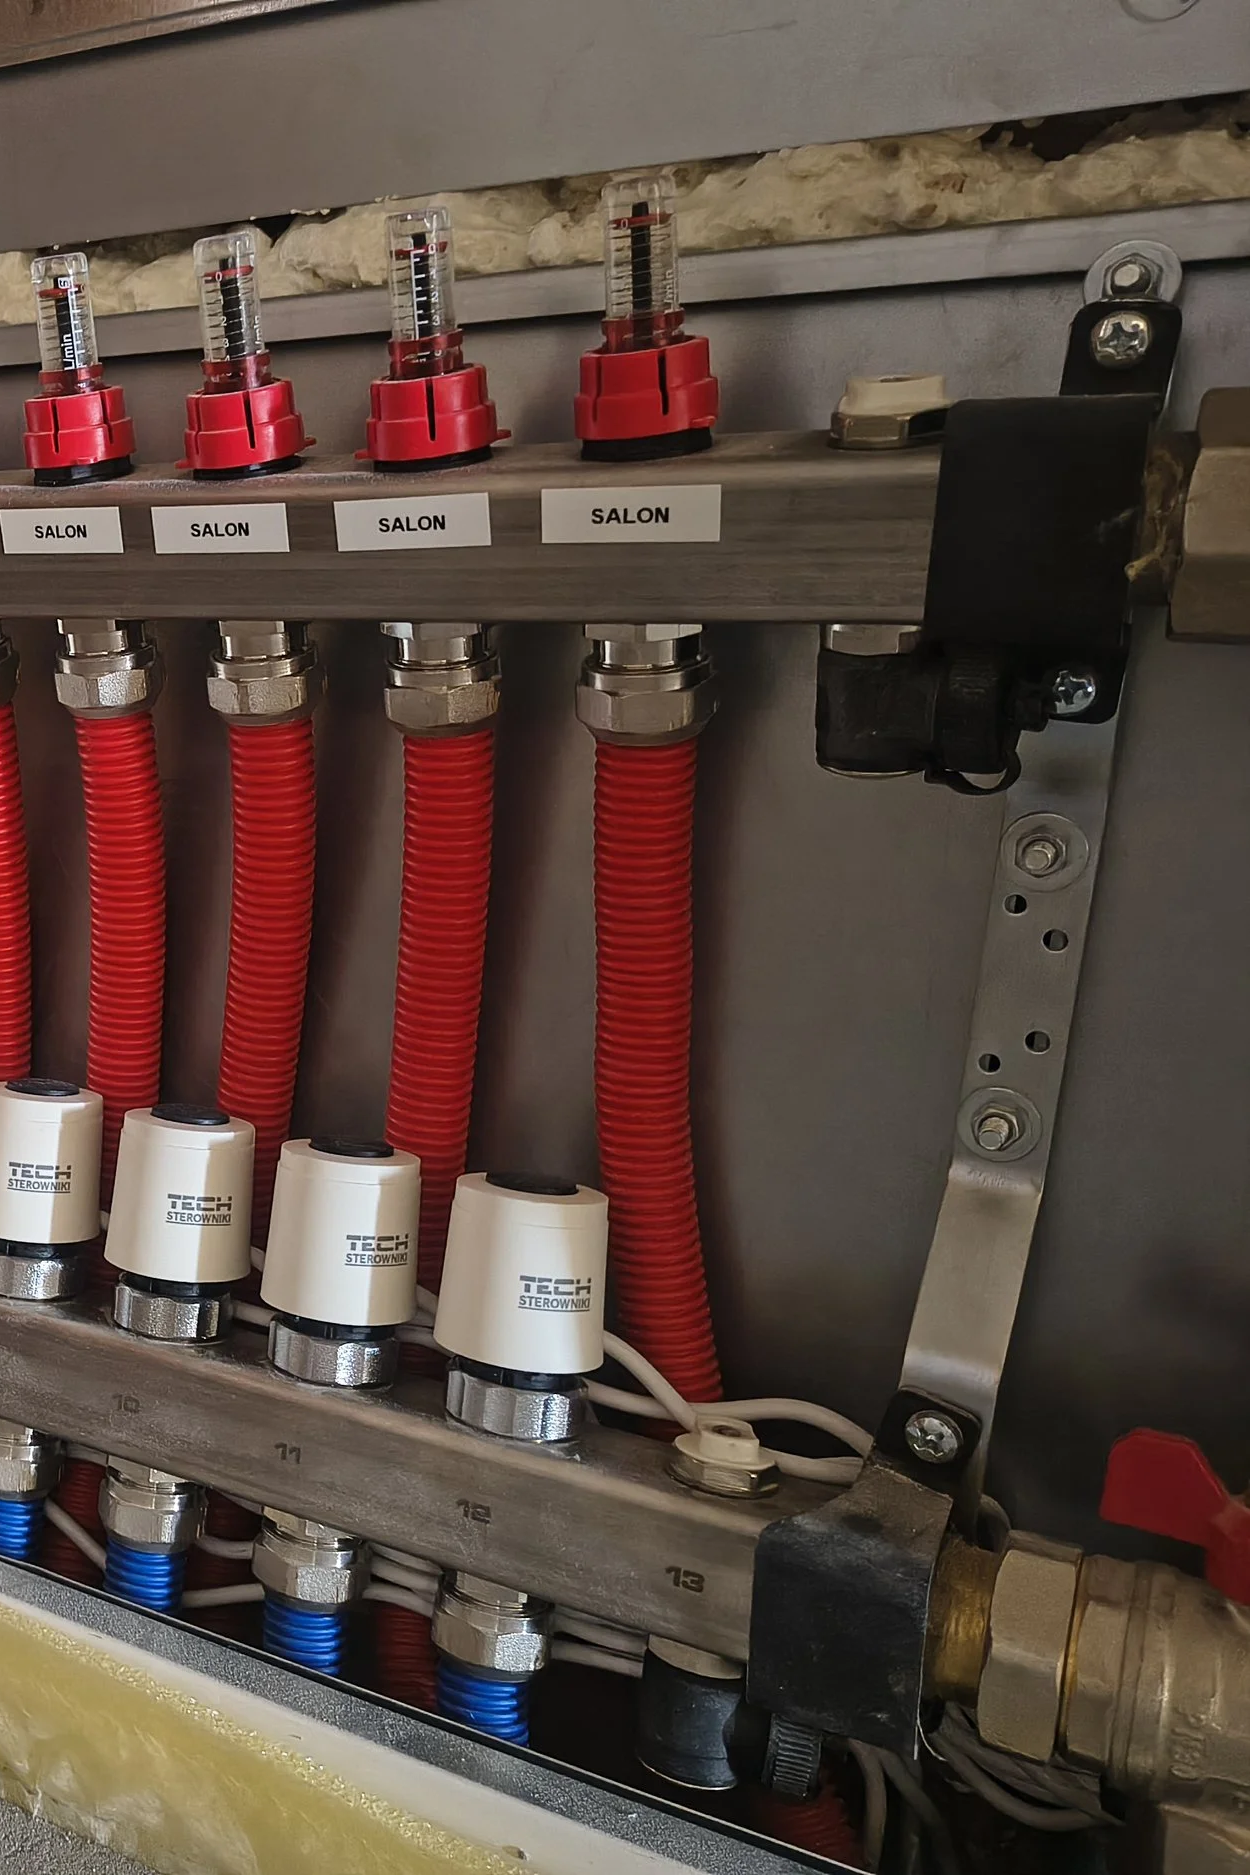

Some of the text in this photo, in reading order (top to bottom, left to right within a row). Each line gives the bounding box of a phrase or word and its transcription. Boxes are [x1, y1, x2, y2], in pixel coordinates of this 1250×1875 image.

[61, 334, 76, 371] L/min
[378, 514, 446, 533] SALON
[590, 506, 670, 525] SALON
[34, 525, 88, 538] SALON
[190, 522, 249, 538] SALON
[8, 1161, 72, 1180] TECH
[7, 1178, 71, 1191] STEROWNIKI
[167, 1193, 233, 1212] TECH
[166, 1211, 232, 1224] STEROWNIKI
[346, 1233, 410, 1252] TECH
[345, 1252, 408, 1264] STEROWNIKI
[519, 1275, 592, 1296] TECH
[518, 1295, 591, 1309] STEROWNIKI
[274, 1442, 302, 1464] 11
[456, 1500, 492, 1524] 12
[665, 1565, 706, 1593] 13
